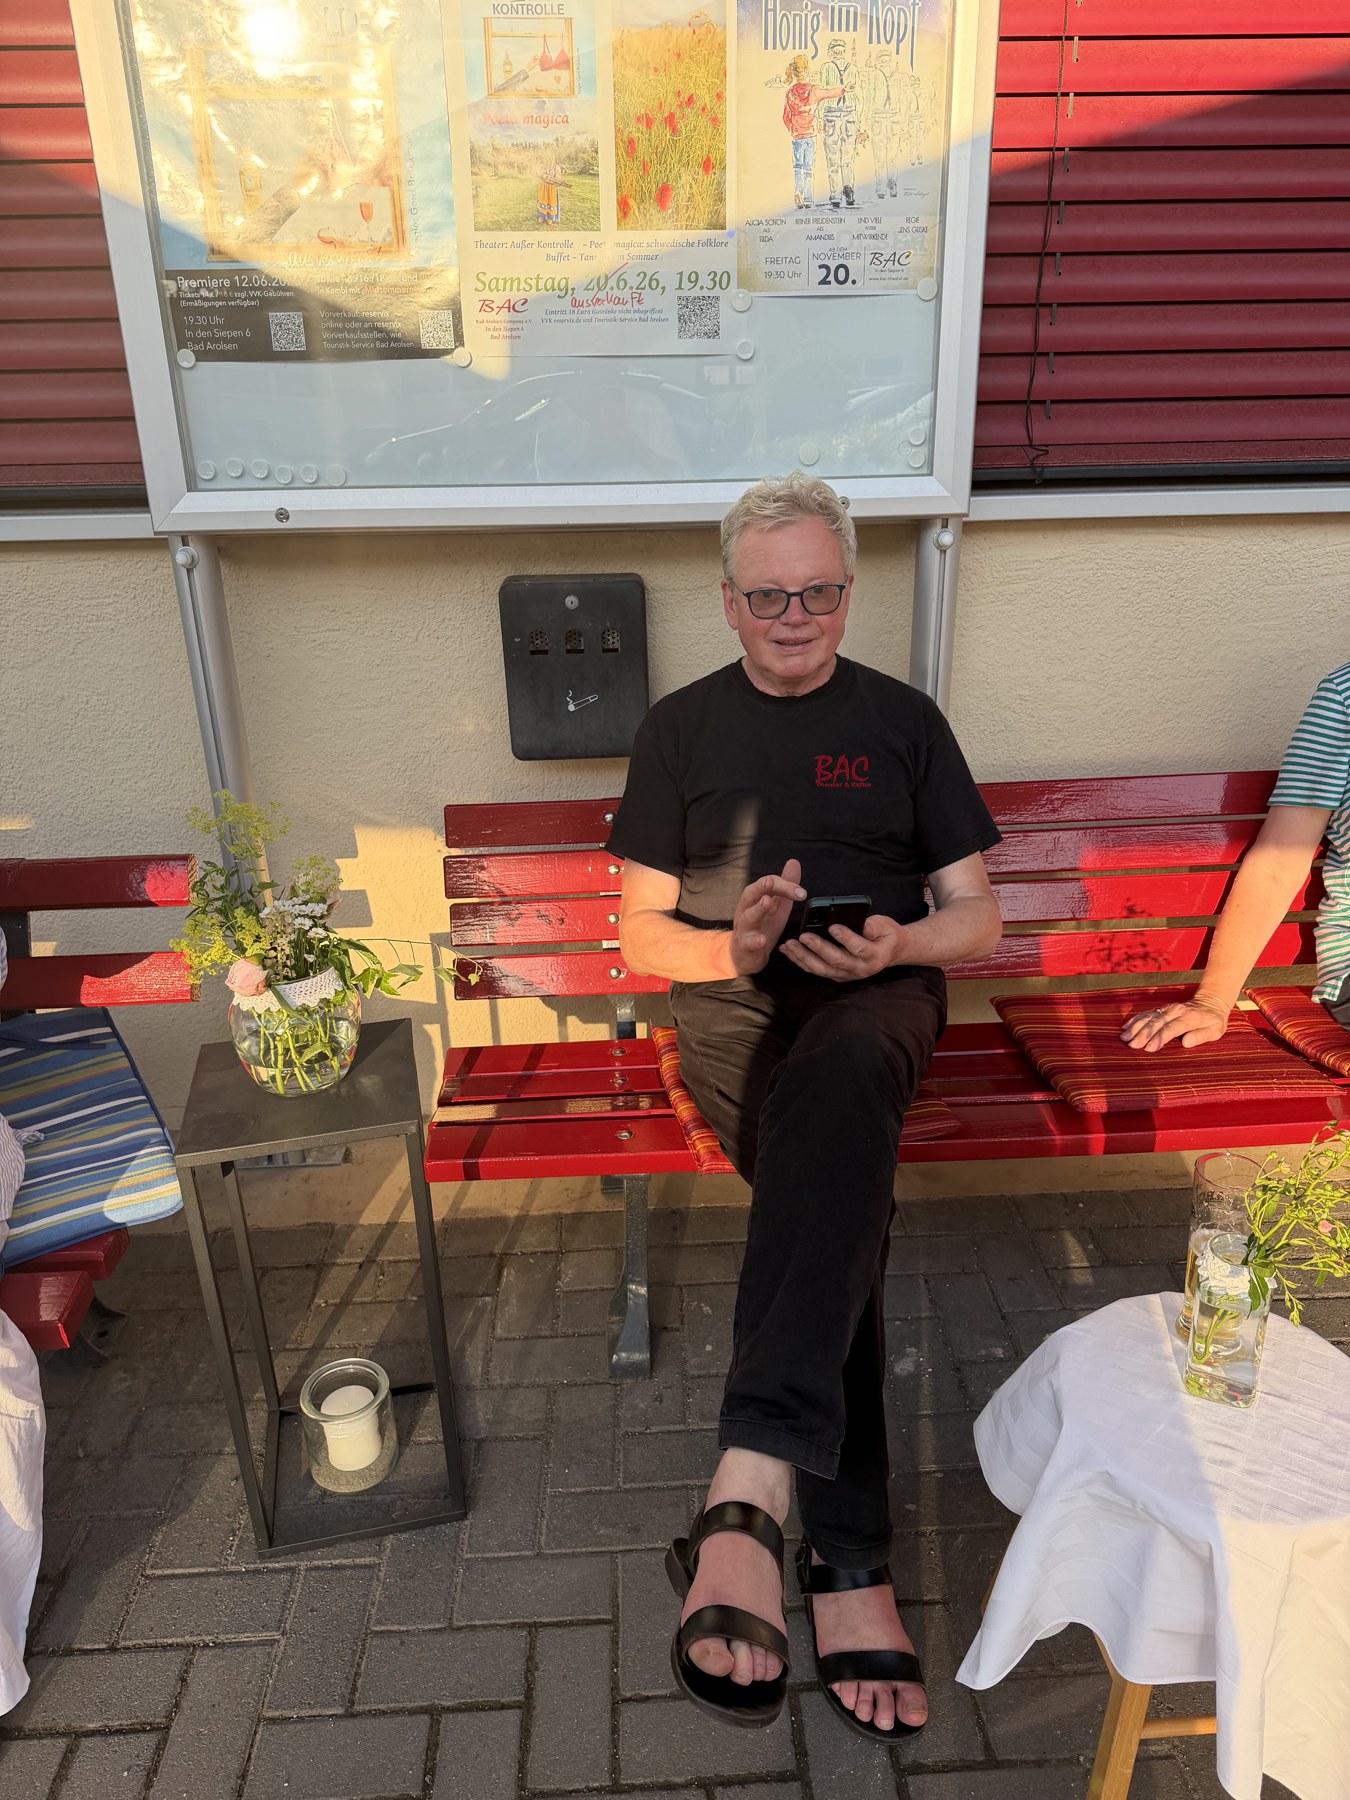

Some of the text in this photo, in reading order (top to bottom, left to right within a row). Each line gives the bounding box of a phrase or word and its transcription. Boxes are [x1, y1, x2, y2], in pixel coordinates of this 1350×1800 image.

[492, 3, 565, 15] KONTROLLE
[763, 0, 821, 60] Honig
[829, 0, 859, 32] im
[523, 112, 569, 128] magica
[474, 240, 508, 249] Theater:
[510, 240, 535, 250] Außer
[537, 240, 573, 249] Kontrolle
[614, 240, 644, 251] magica:
[646, 239, 695, 248] schwedische
[697, 238, 729, 248] Folklore
[545, 252, 570, 263] Buffet
[627, 253, 660, 261] Sommer
[765, 256, 801, 265] FREITAG
[812, 252, 861, 261] NOVEMBER
[869, 250, 912, 268] BAC
[764, 270, 802, 279] 19:30 Uhr
[817, 263, 857, 285] 20.
[177, 276, 230, 288] Premiere
[474, 270, 732, 299] Samstag, 20.6.26, 19.30
[234, 291, 249, 300] zzgl.
[249, 290, 294, 298] VVK-Gebühren
[326, 286, 348, 294] Kombi
[350, 286, 361, 294] mit
[180, 299, 260, 309] (Ermäßigungen verfügbar)
[478, 298, 529, 316] BAC
[320, 310, 390, 318] Vorverkauf: reservix
[184, 315, 225, 325] 19.30 Uhr
[321, 320, 343, 329] online
[345, 320, 362, 328] oder
[185, 328, 252, 341] In den Siepen 6
[322, 330, 389, 339] Vorverkaufsstellen,
[187, 341, 239, 351] Bad Arolsen
[322, 341, 375, 349] Touristik-Service
[375, 340, 389, 348] Bad
[814, 754, 869, 783] BAC
